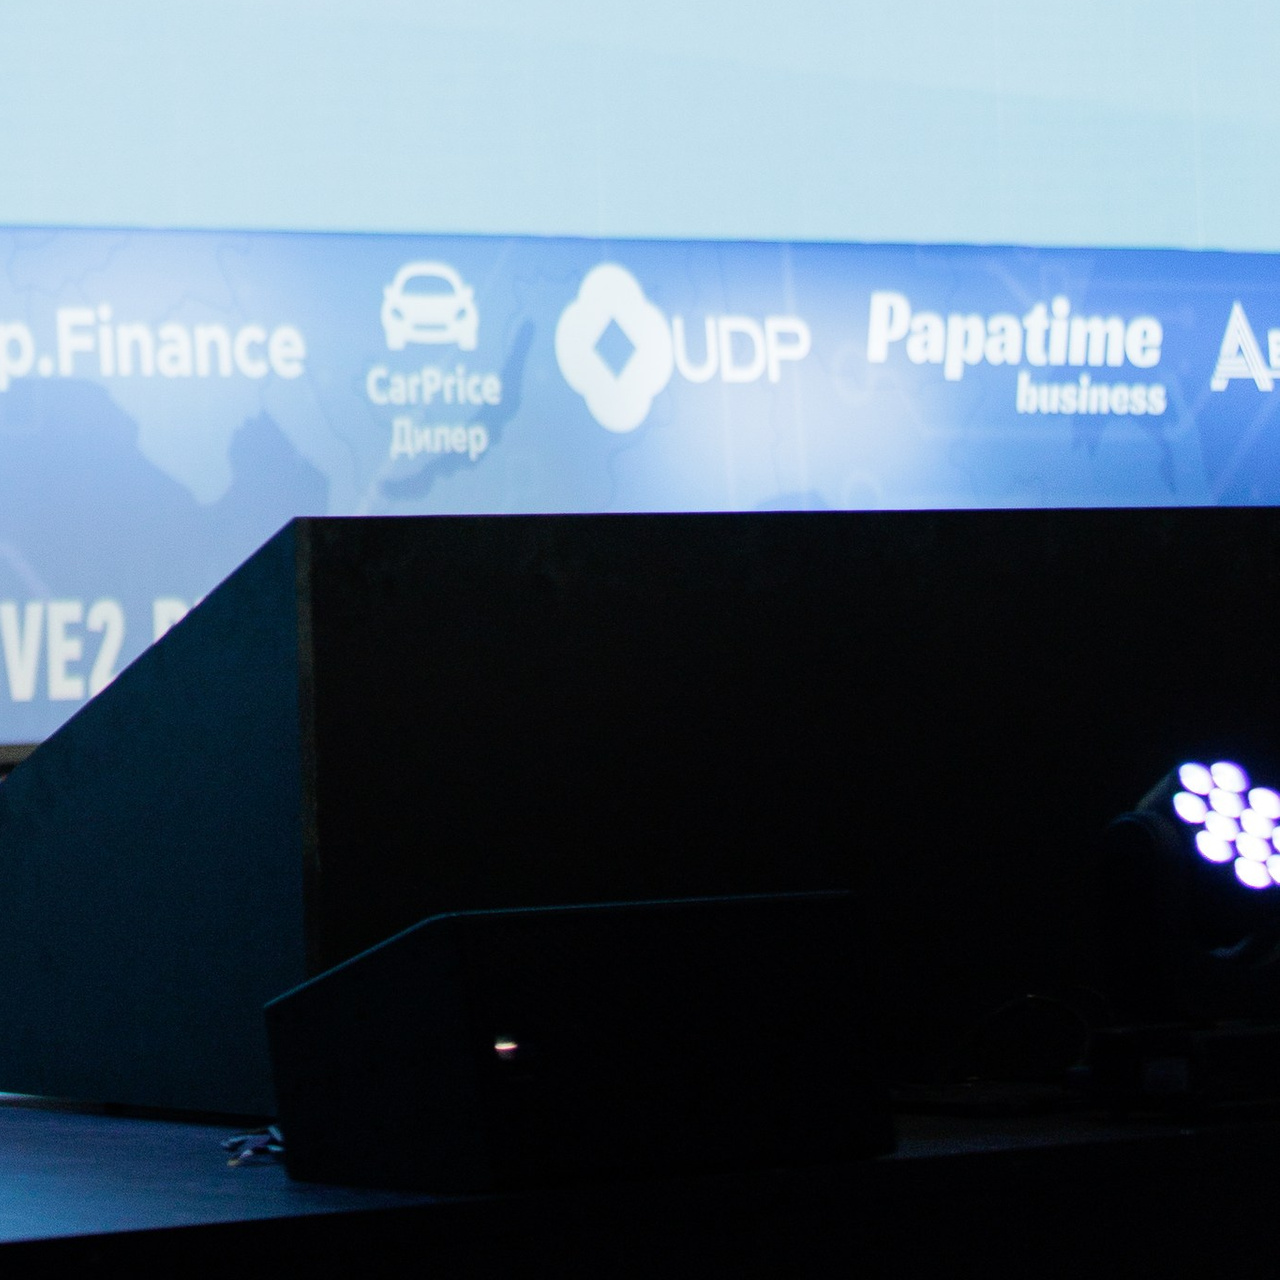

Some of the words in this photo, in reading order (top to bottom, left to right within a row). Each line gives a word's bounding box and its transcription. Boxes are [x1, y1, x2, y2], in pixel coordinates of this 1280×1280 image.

[672, 314, 812, 384] UDP
[866, 289, 1164, 382] Papatime
[366, 363, 502, 406] CarPrice
[1016, 370, 1168, 417] business
[389, 415, 489, 462] Дилер
